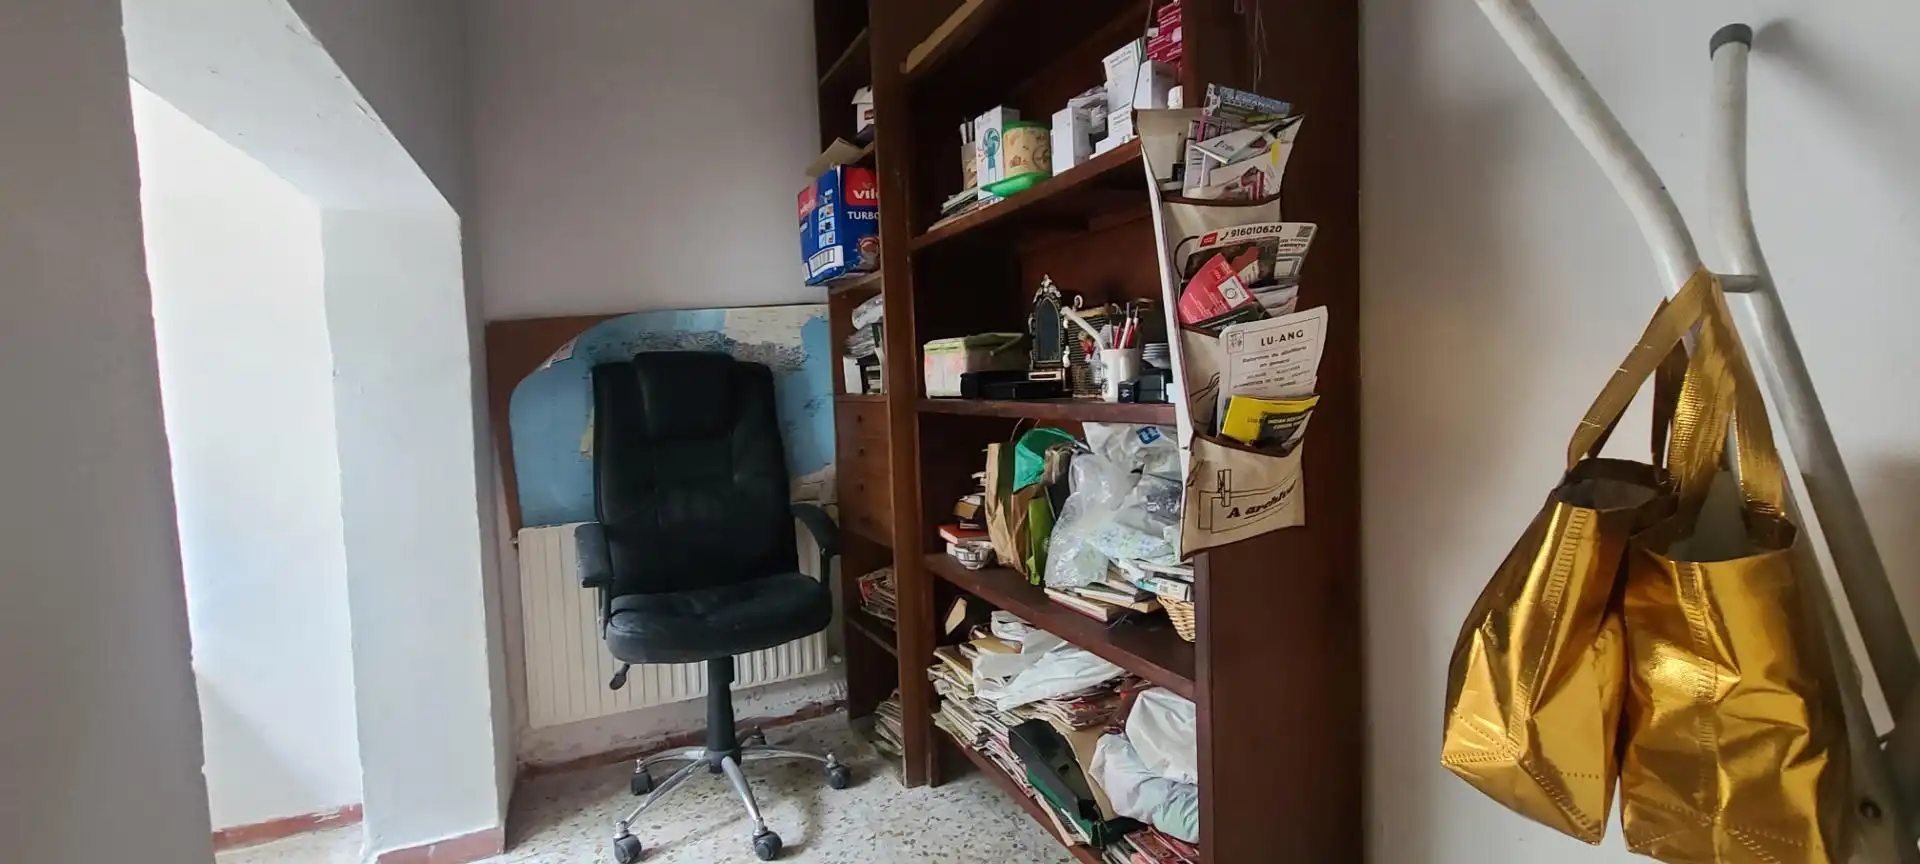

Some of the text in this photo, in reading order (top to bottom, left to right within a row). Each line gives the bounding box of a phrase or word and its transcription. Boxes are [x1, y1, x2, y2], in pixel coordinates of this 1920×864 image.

[1230, 225, 1282, 238] 916010620
[1261, 329, 1304, 347] LU-ANG
[1226, 506, 1241, 519] A
